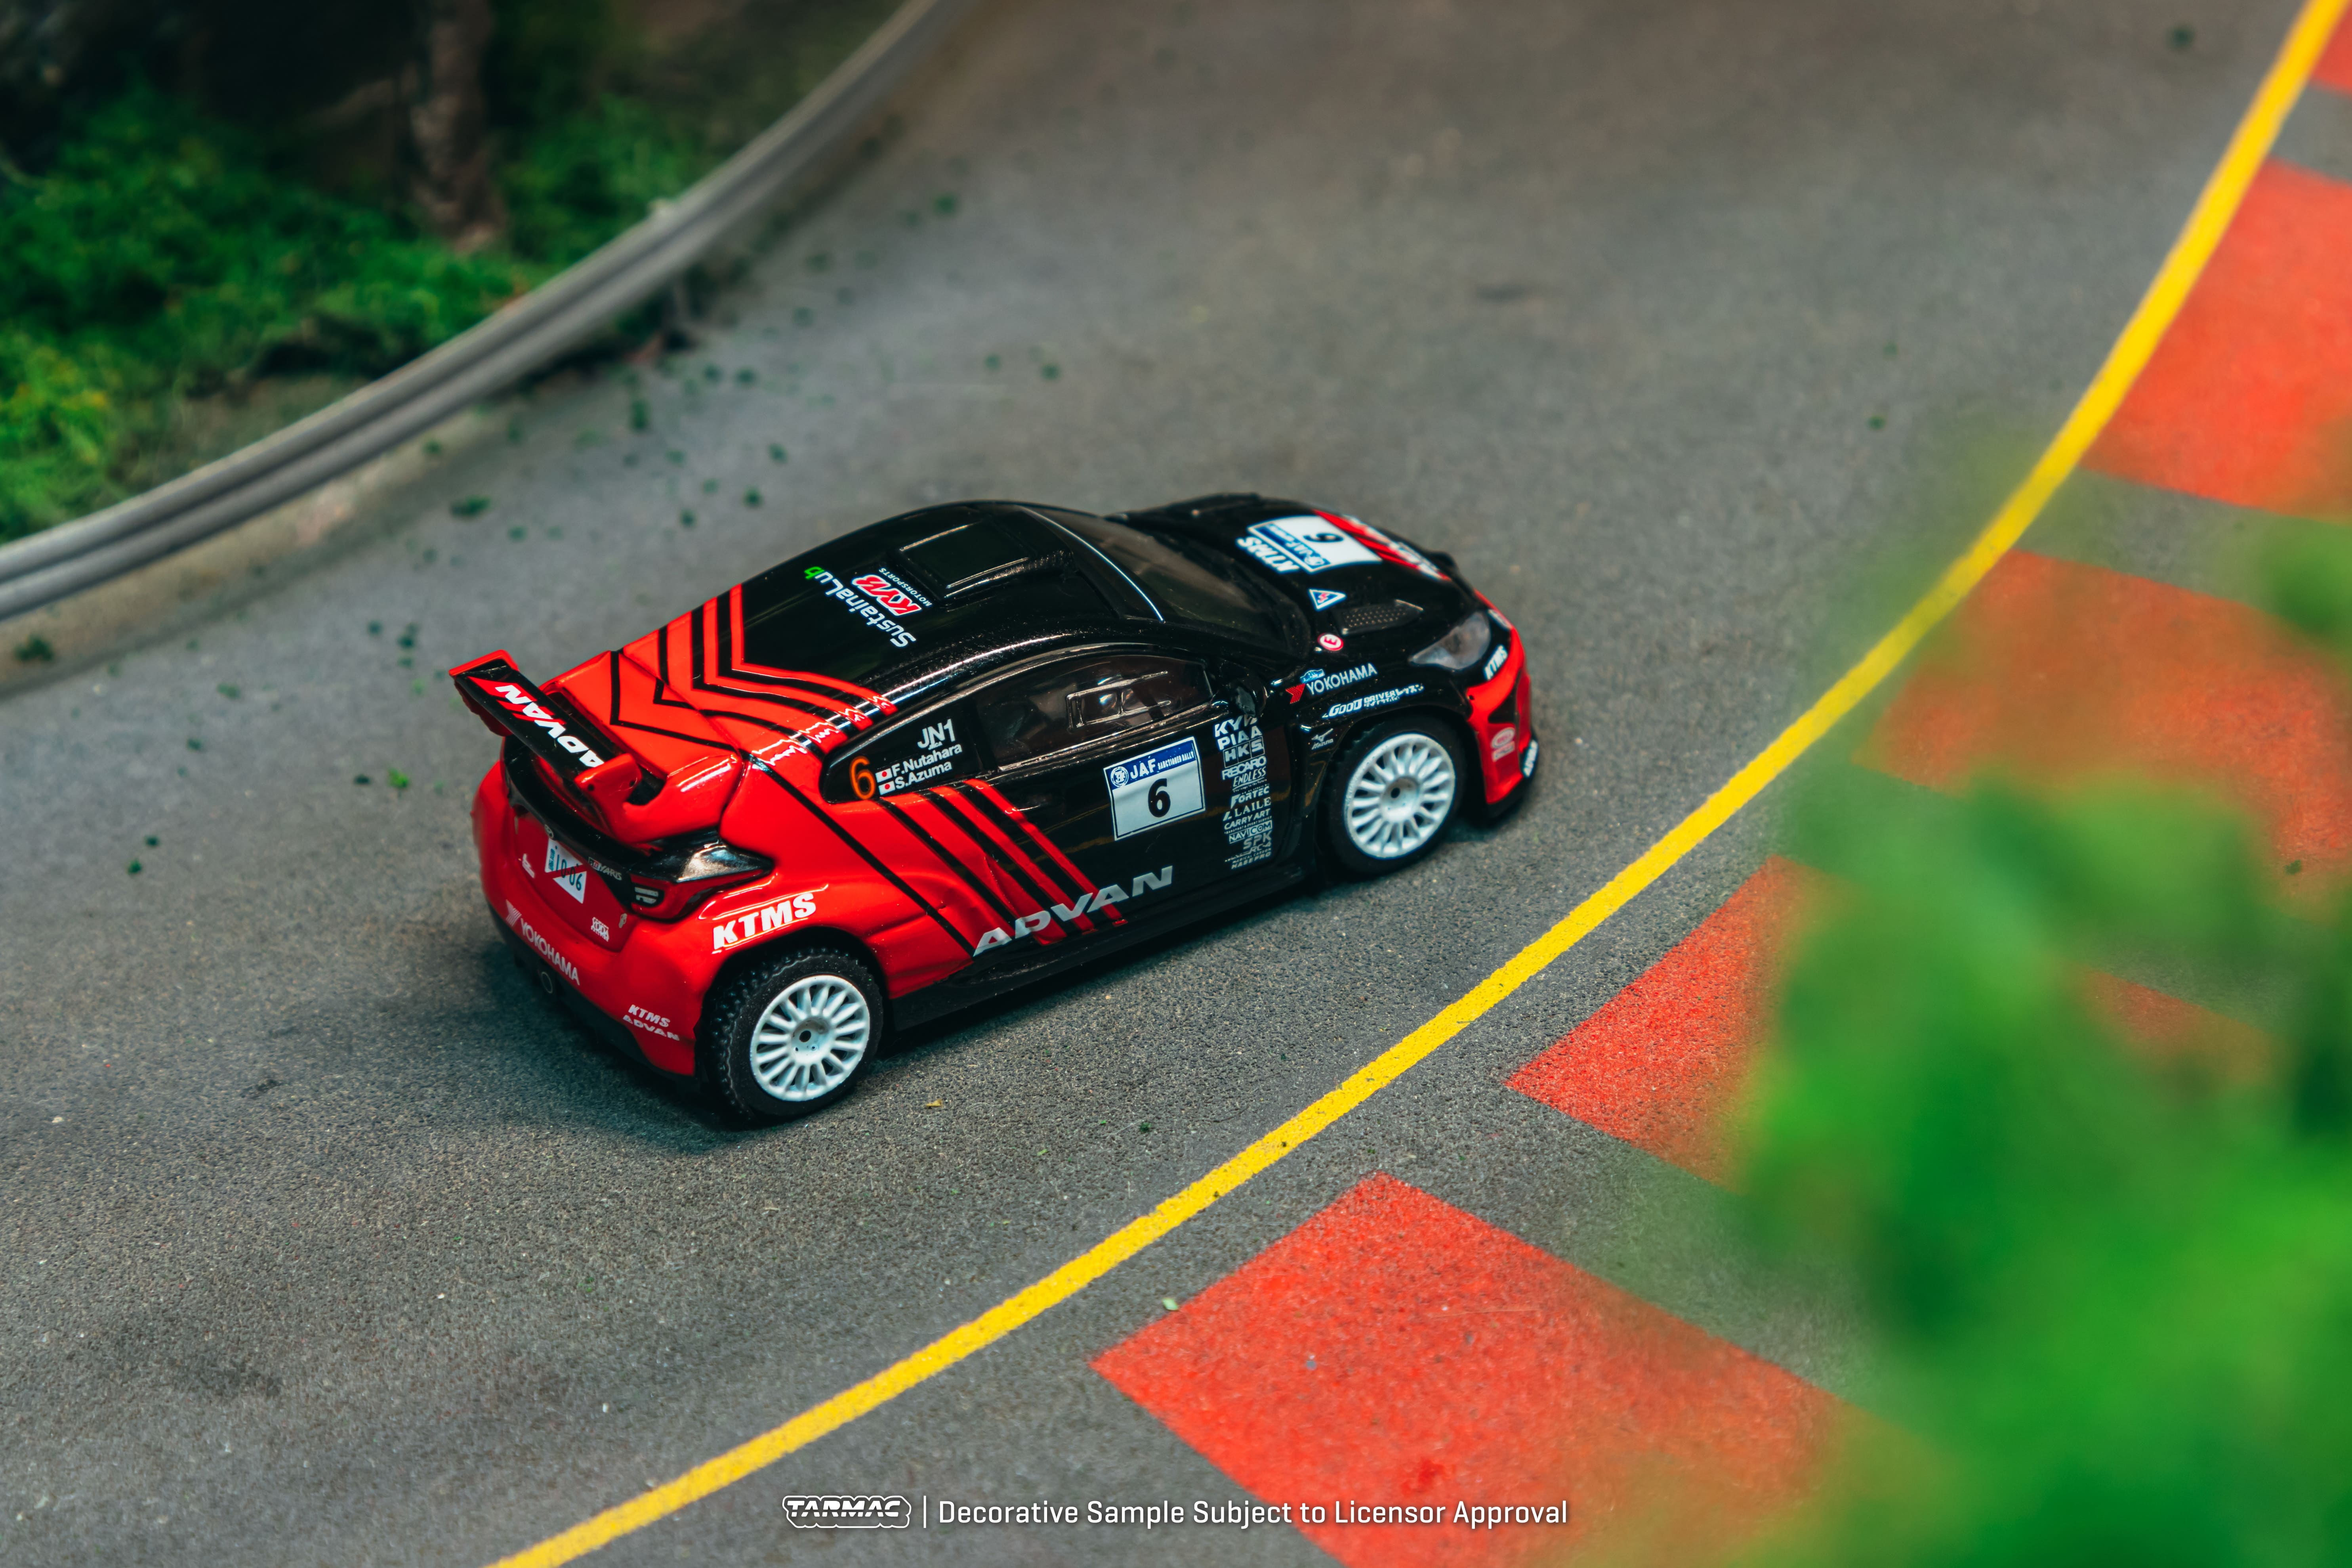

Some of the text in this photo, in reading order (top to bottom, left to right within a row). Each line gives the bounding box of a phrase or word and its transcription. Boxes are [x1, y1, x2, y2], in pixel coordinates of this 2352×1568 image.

[1303, 532, 1344, 543] 6
[1236, 537, 1299, 571] KTMS
[852, 575, 922, 616] KYB
[879, 568, 932, 607] MOTORSPORTS
[1307, 663, 1377, 695] YOKOHAMA
[495, 685, 605, 767] ADVAN
[918, 719, 956, 749] JN1
[1217, 725, 1262, 750] PIAA
[891, 744, 963, 777] F.Nutahara
[1224, 739, 1264, 762] HKS
[849, 756, 877, 800] 6
[894, 761, 952, 789] S.Azuma
[1130, 758, 1156, 779] JAF
[1222, 755, 1267, 780] RECARO
[1233, 767, 1266, 788] ENDLESS
[1148, 778, 1171, 818] 6
[1230, 785, 1270, 809] FORTEC
[1234, 797, 1271, 817] LAILE
[1224, 808, 1271, 830] CARRY ART
[1229, 821, 1272, 843] NAVICOM
[1243, 830, 1272, 849] SPK
[598, 863, 622, 881] YARIS
[713, 893, 816, 950] KTMS
[973, 865, 1173, 957] ADVAN
[521, 918, 580, 986] YOKOHAMA
[623, 1015, 680, 1041] ADVAN
[628, 1004, 671, 1027] KTMS
